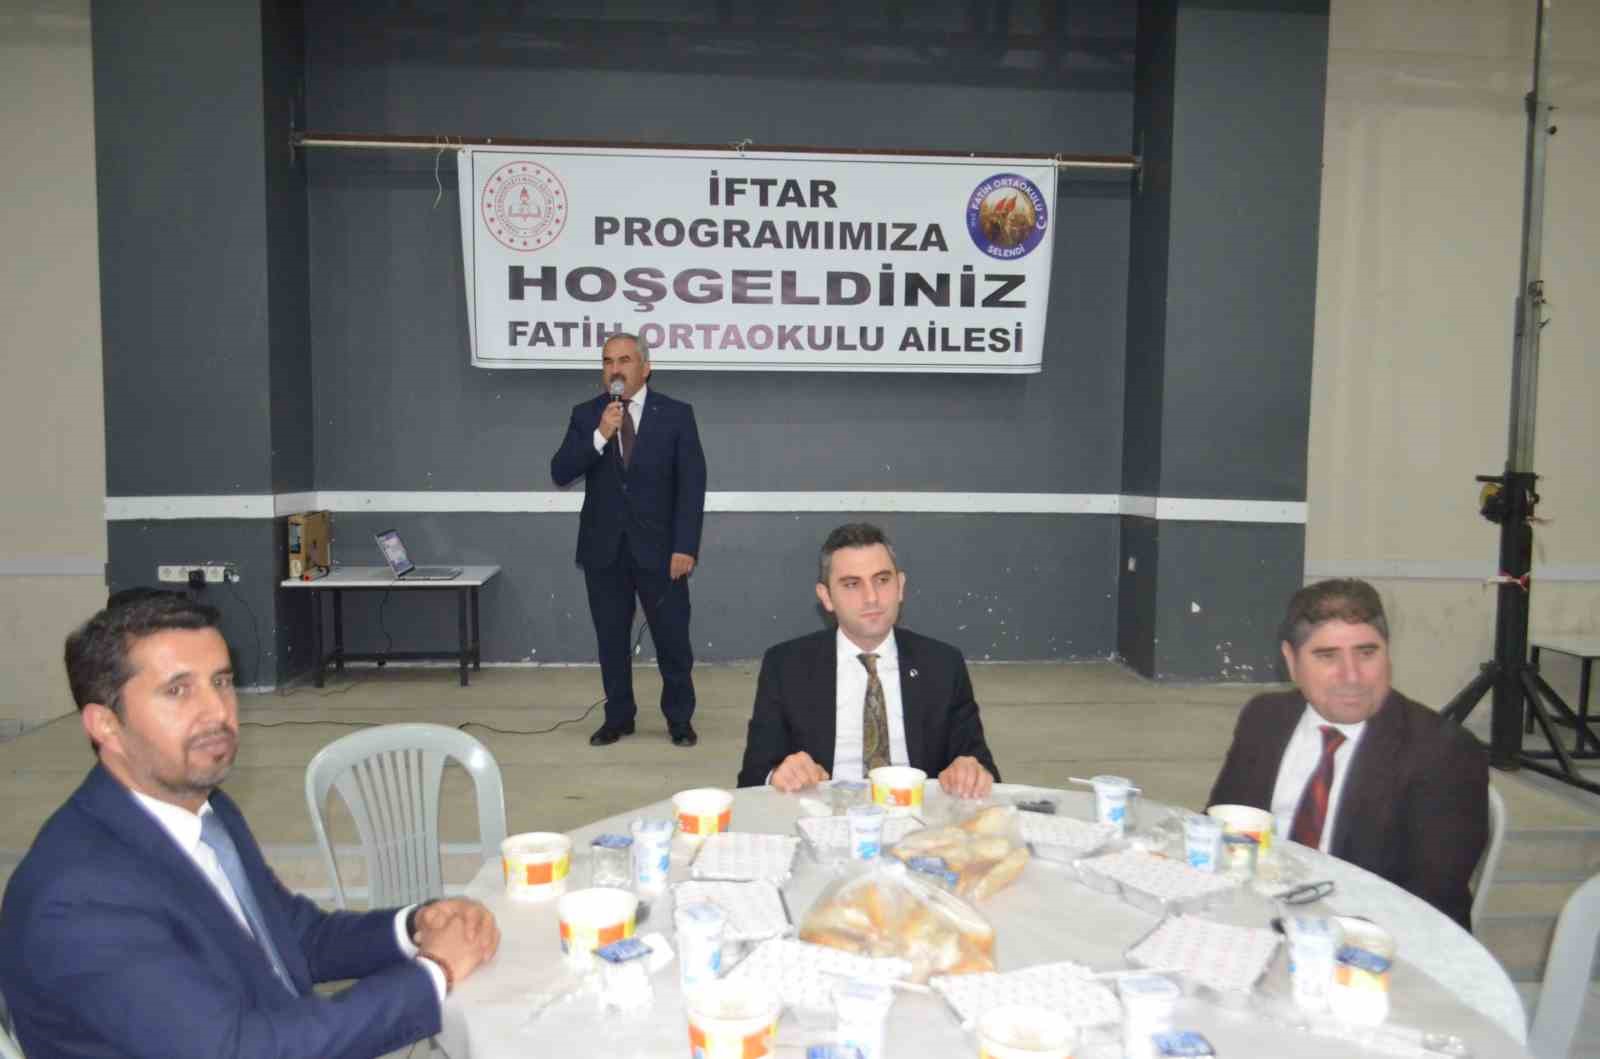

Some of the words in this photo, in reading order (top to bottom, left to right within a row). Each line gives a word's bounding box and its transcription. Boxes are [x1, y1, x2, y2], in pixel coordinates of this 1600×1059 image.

[709, 170, 837, 208] İFTAR
[595, 216, 949, 252] PROGRAMIMIZA
[508, 263, 1026, 312] HOŞGELDİNİZ
[639, 323, 885, 352] ORTAOKULU
[899, 321, 1023, 352] AİLESİ
